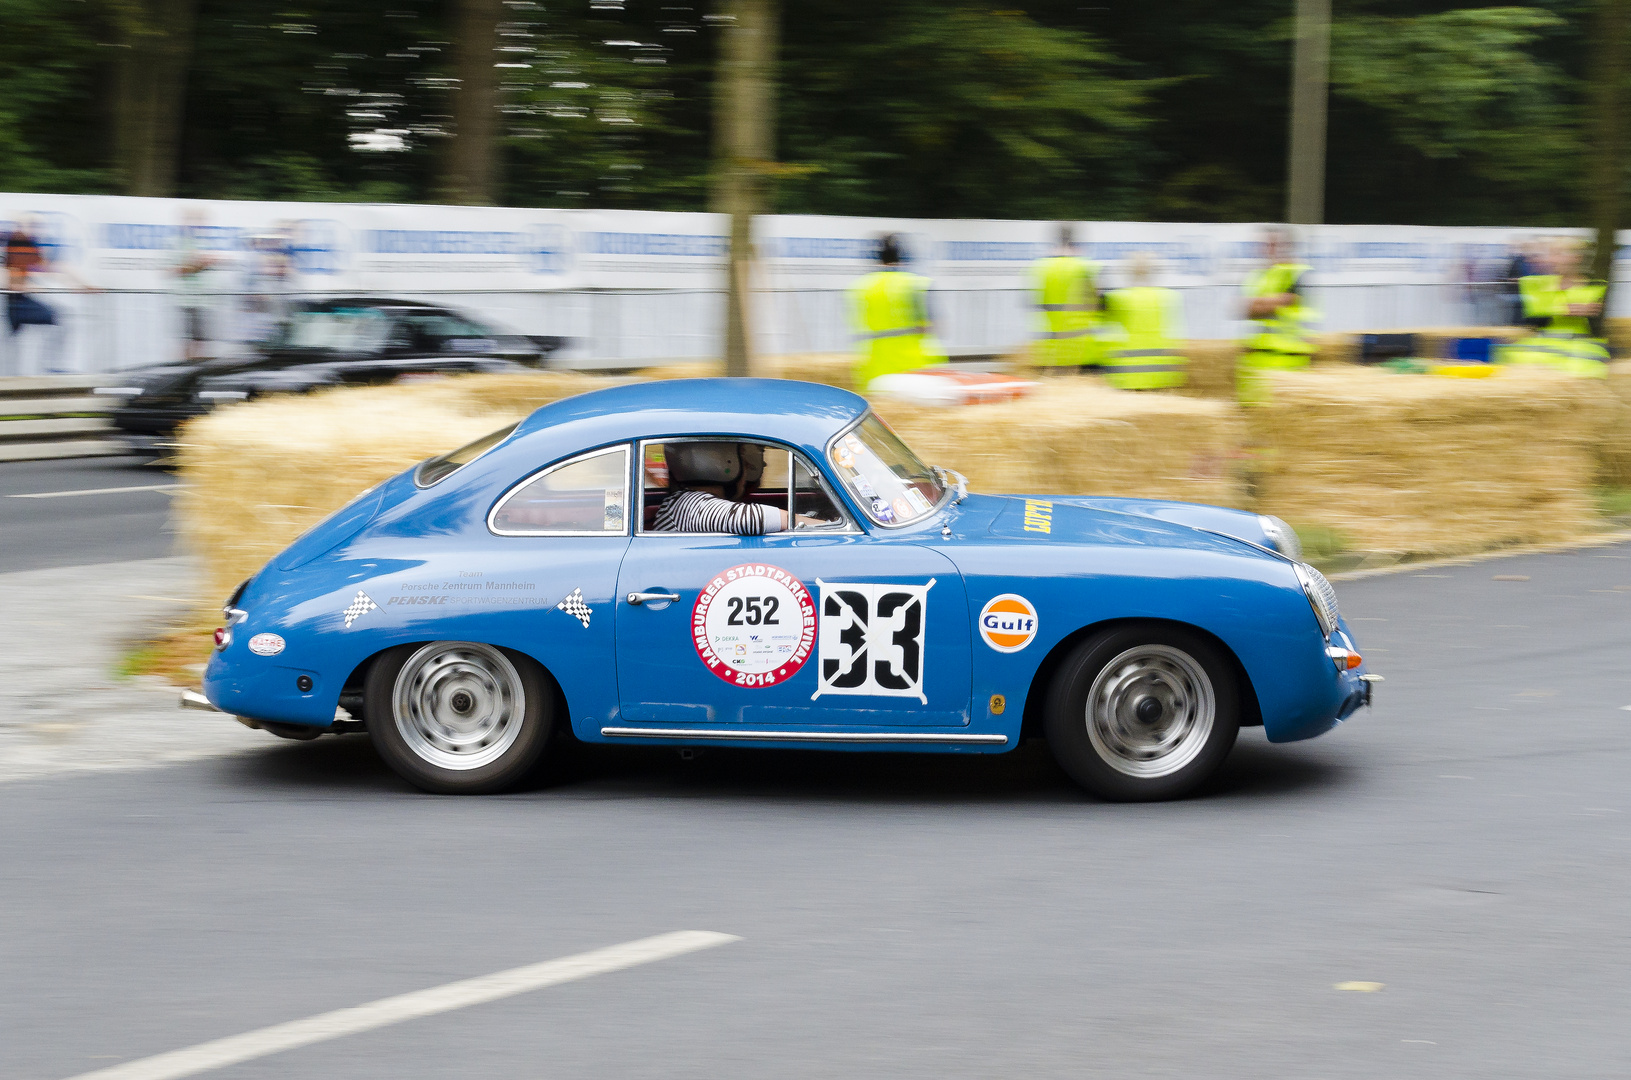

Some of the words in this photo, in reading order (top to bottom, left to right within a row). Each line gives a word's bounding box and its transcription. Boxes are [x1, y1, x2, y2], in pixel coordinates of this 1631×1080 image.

[401, 583, 439, 591] Porsche
[442, 582, 482, 590] Zentrum
[485, 581, 536, 590] Mannheim
[387, 596, 449, 605] PENSKE
[450, 597, 548, 605] SPORTWAGENZENTRUM
[727, 596, 780, 626] 252
[694, 577, 726, 668] HAMBURGER
[983, 615, 1034, 632] Gulf
[823, 590, 922, 690] 33
[735, 672, 776, 686] 2014
